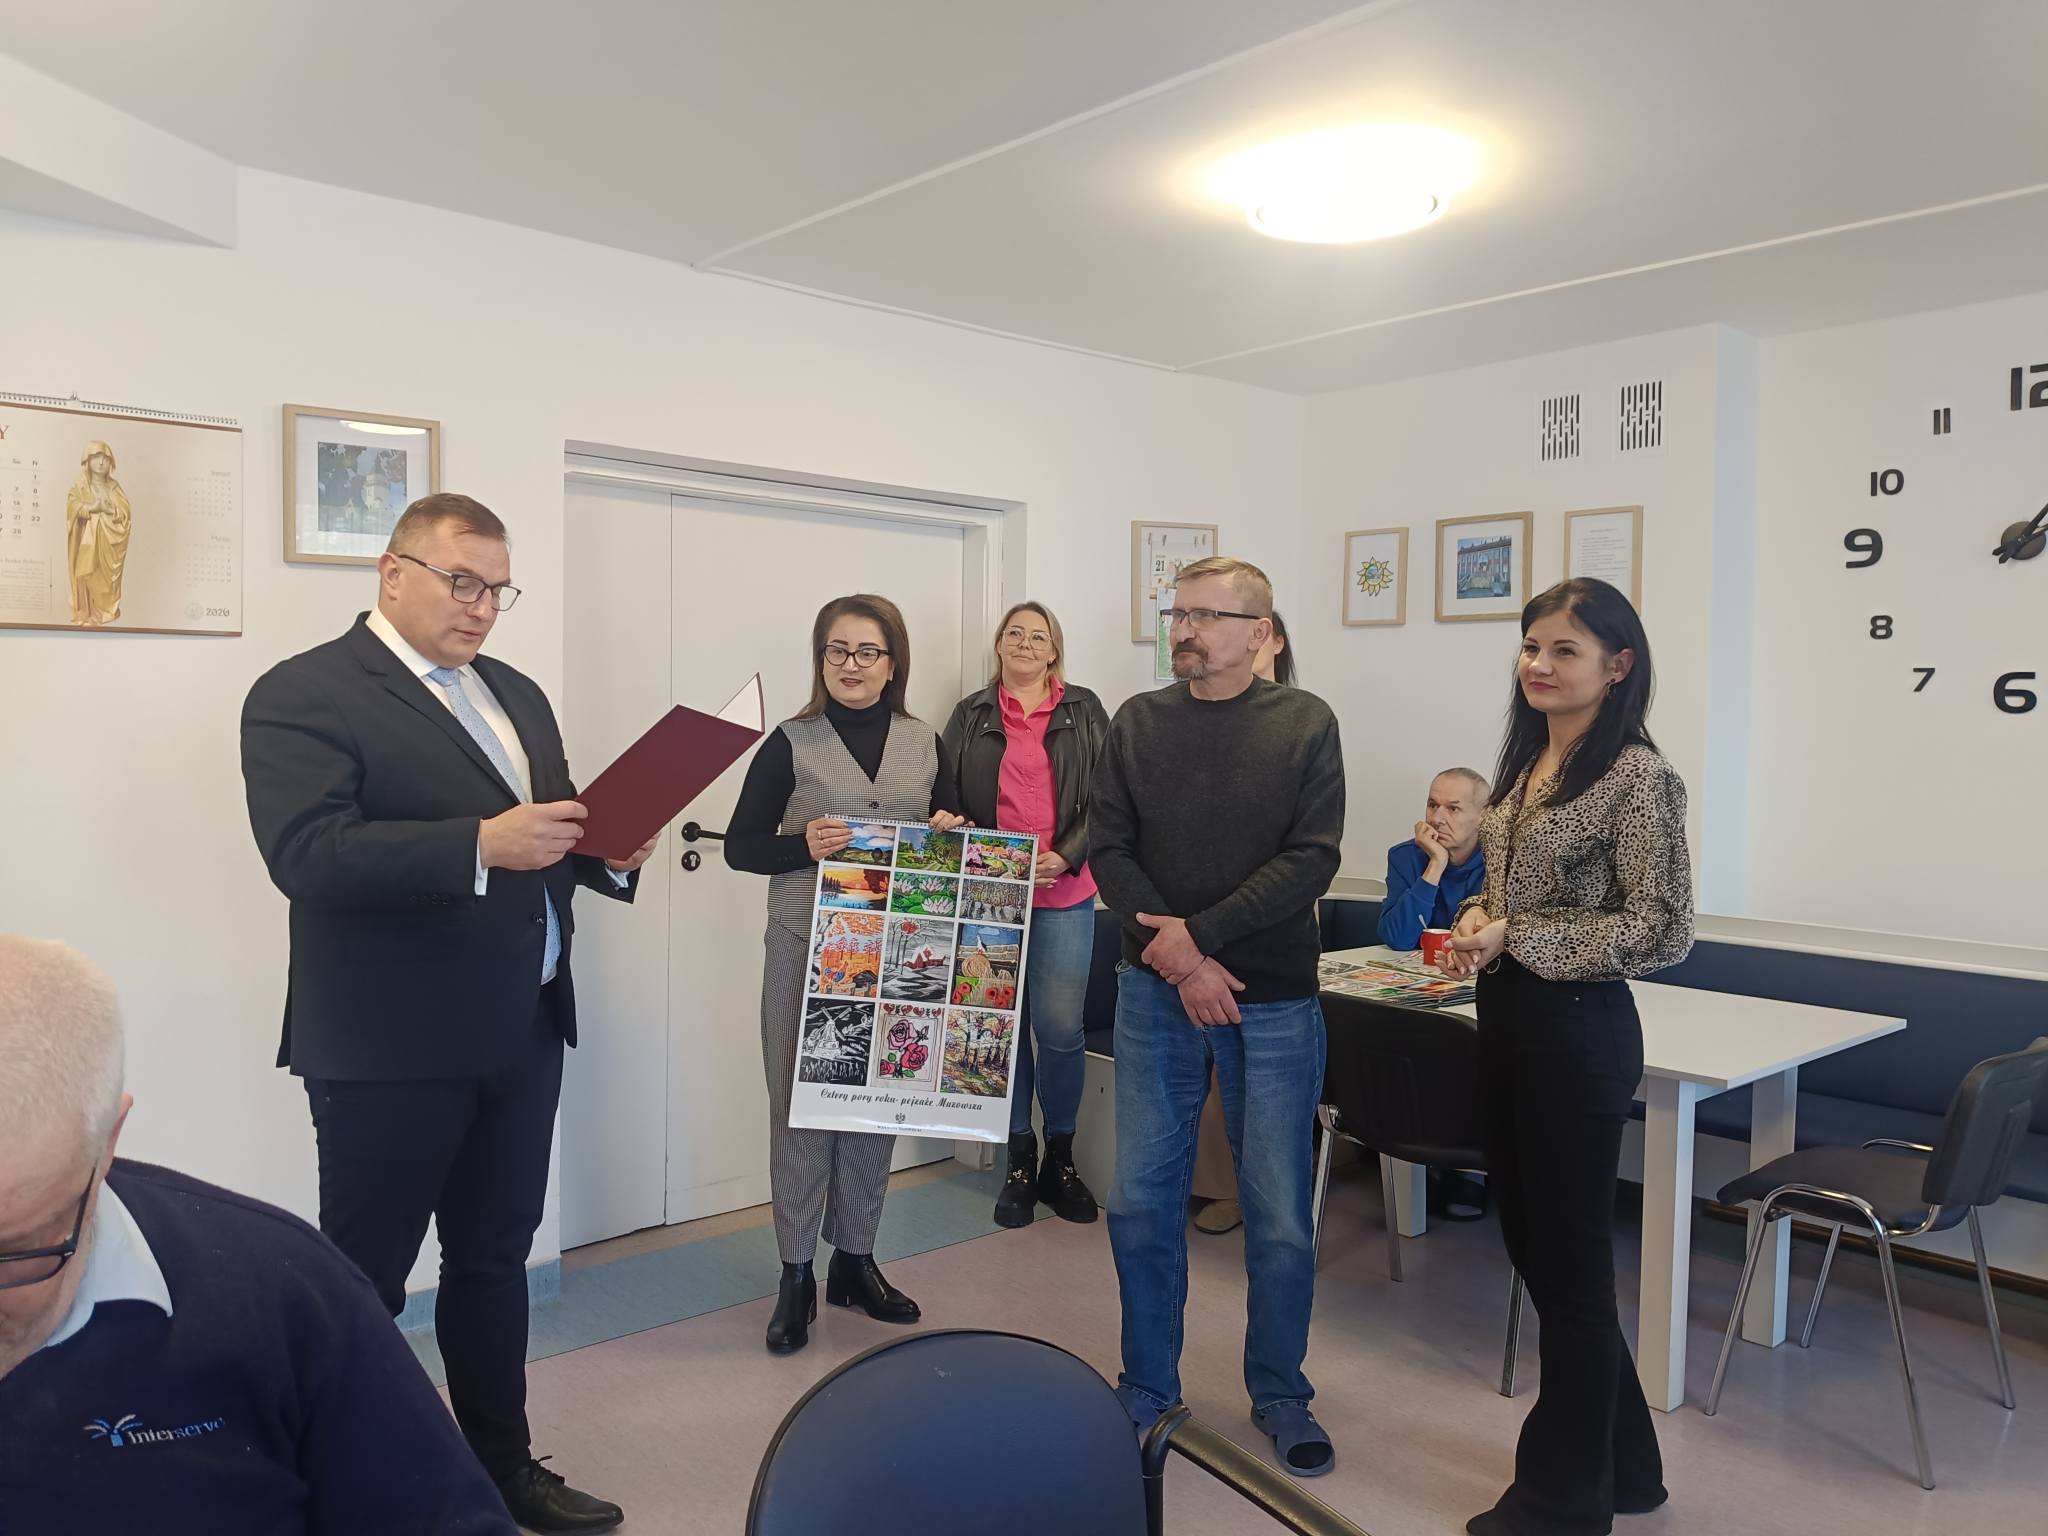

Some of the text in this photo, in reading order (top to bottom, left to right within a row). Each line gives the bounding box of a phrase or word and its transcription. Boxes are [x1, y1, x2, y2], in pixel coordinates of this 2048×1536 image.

[1933, 408, 1951, 435] 11
[1870, 468, 1905, 497] 10
[1843, 528, 1883, 569] 9
[1155, 560, 1165, 571] 21
[1869, 615, 1894, 640] 8
[1912, 667, 1936, 693] 7
[1993, 671, 2038, 714] 6
[820, 1088, 848, 1101] Cztery
[851, 1091, 872, 1104] pory
[936, 1098, 983, 1111] Mazowsza
